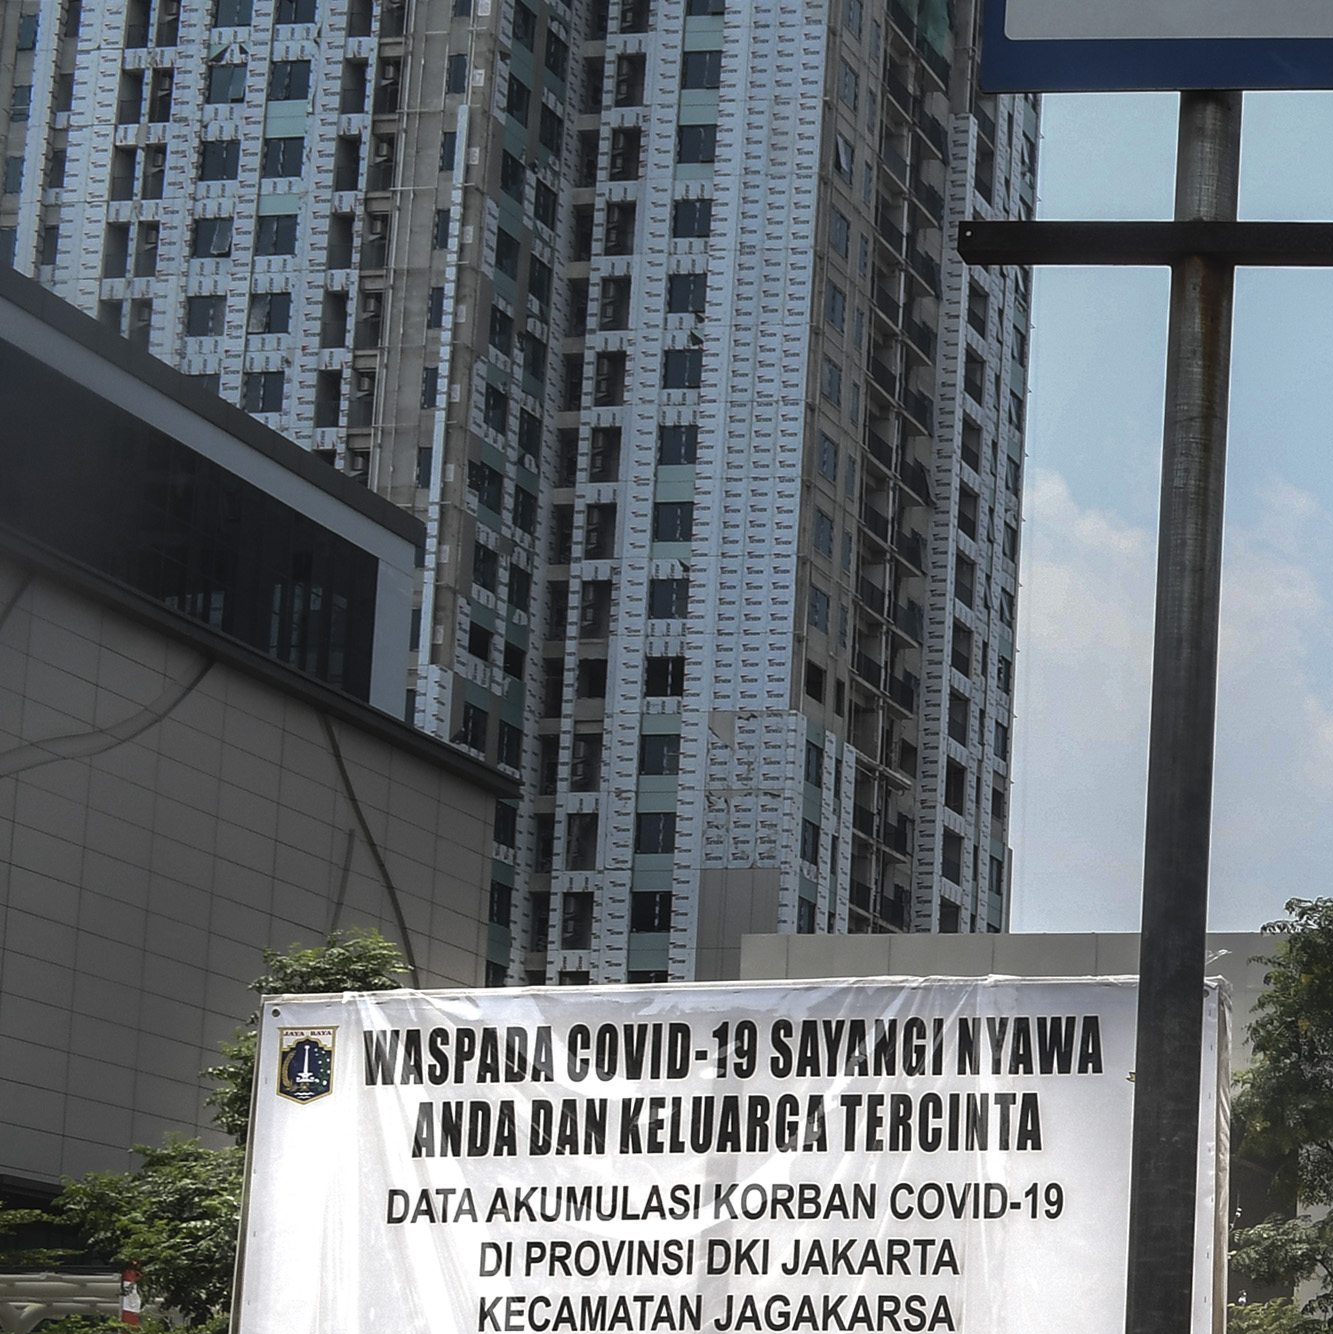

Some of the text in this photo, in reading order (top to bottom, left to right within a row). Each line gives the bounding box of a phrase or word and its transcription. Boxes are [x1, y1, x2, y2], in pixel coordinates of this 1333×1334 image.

[363, 1016, 1102, 1085] WASPADA COVID-19 SAYANGI NYAWA
[412, 1093, 1041, 1158] ANDA DAN KELUARGA TERCINTA
[387, 1183, 1063, 1224] DATA AKUMULASI KORBAN COVID-19
[480, 1239, 959, 1277] DI PROVINSI DKI JAKARTA
[479, 1295, 955, 1332] KECAMATAN JAGAKARSA
